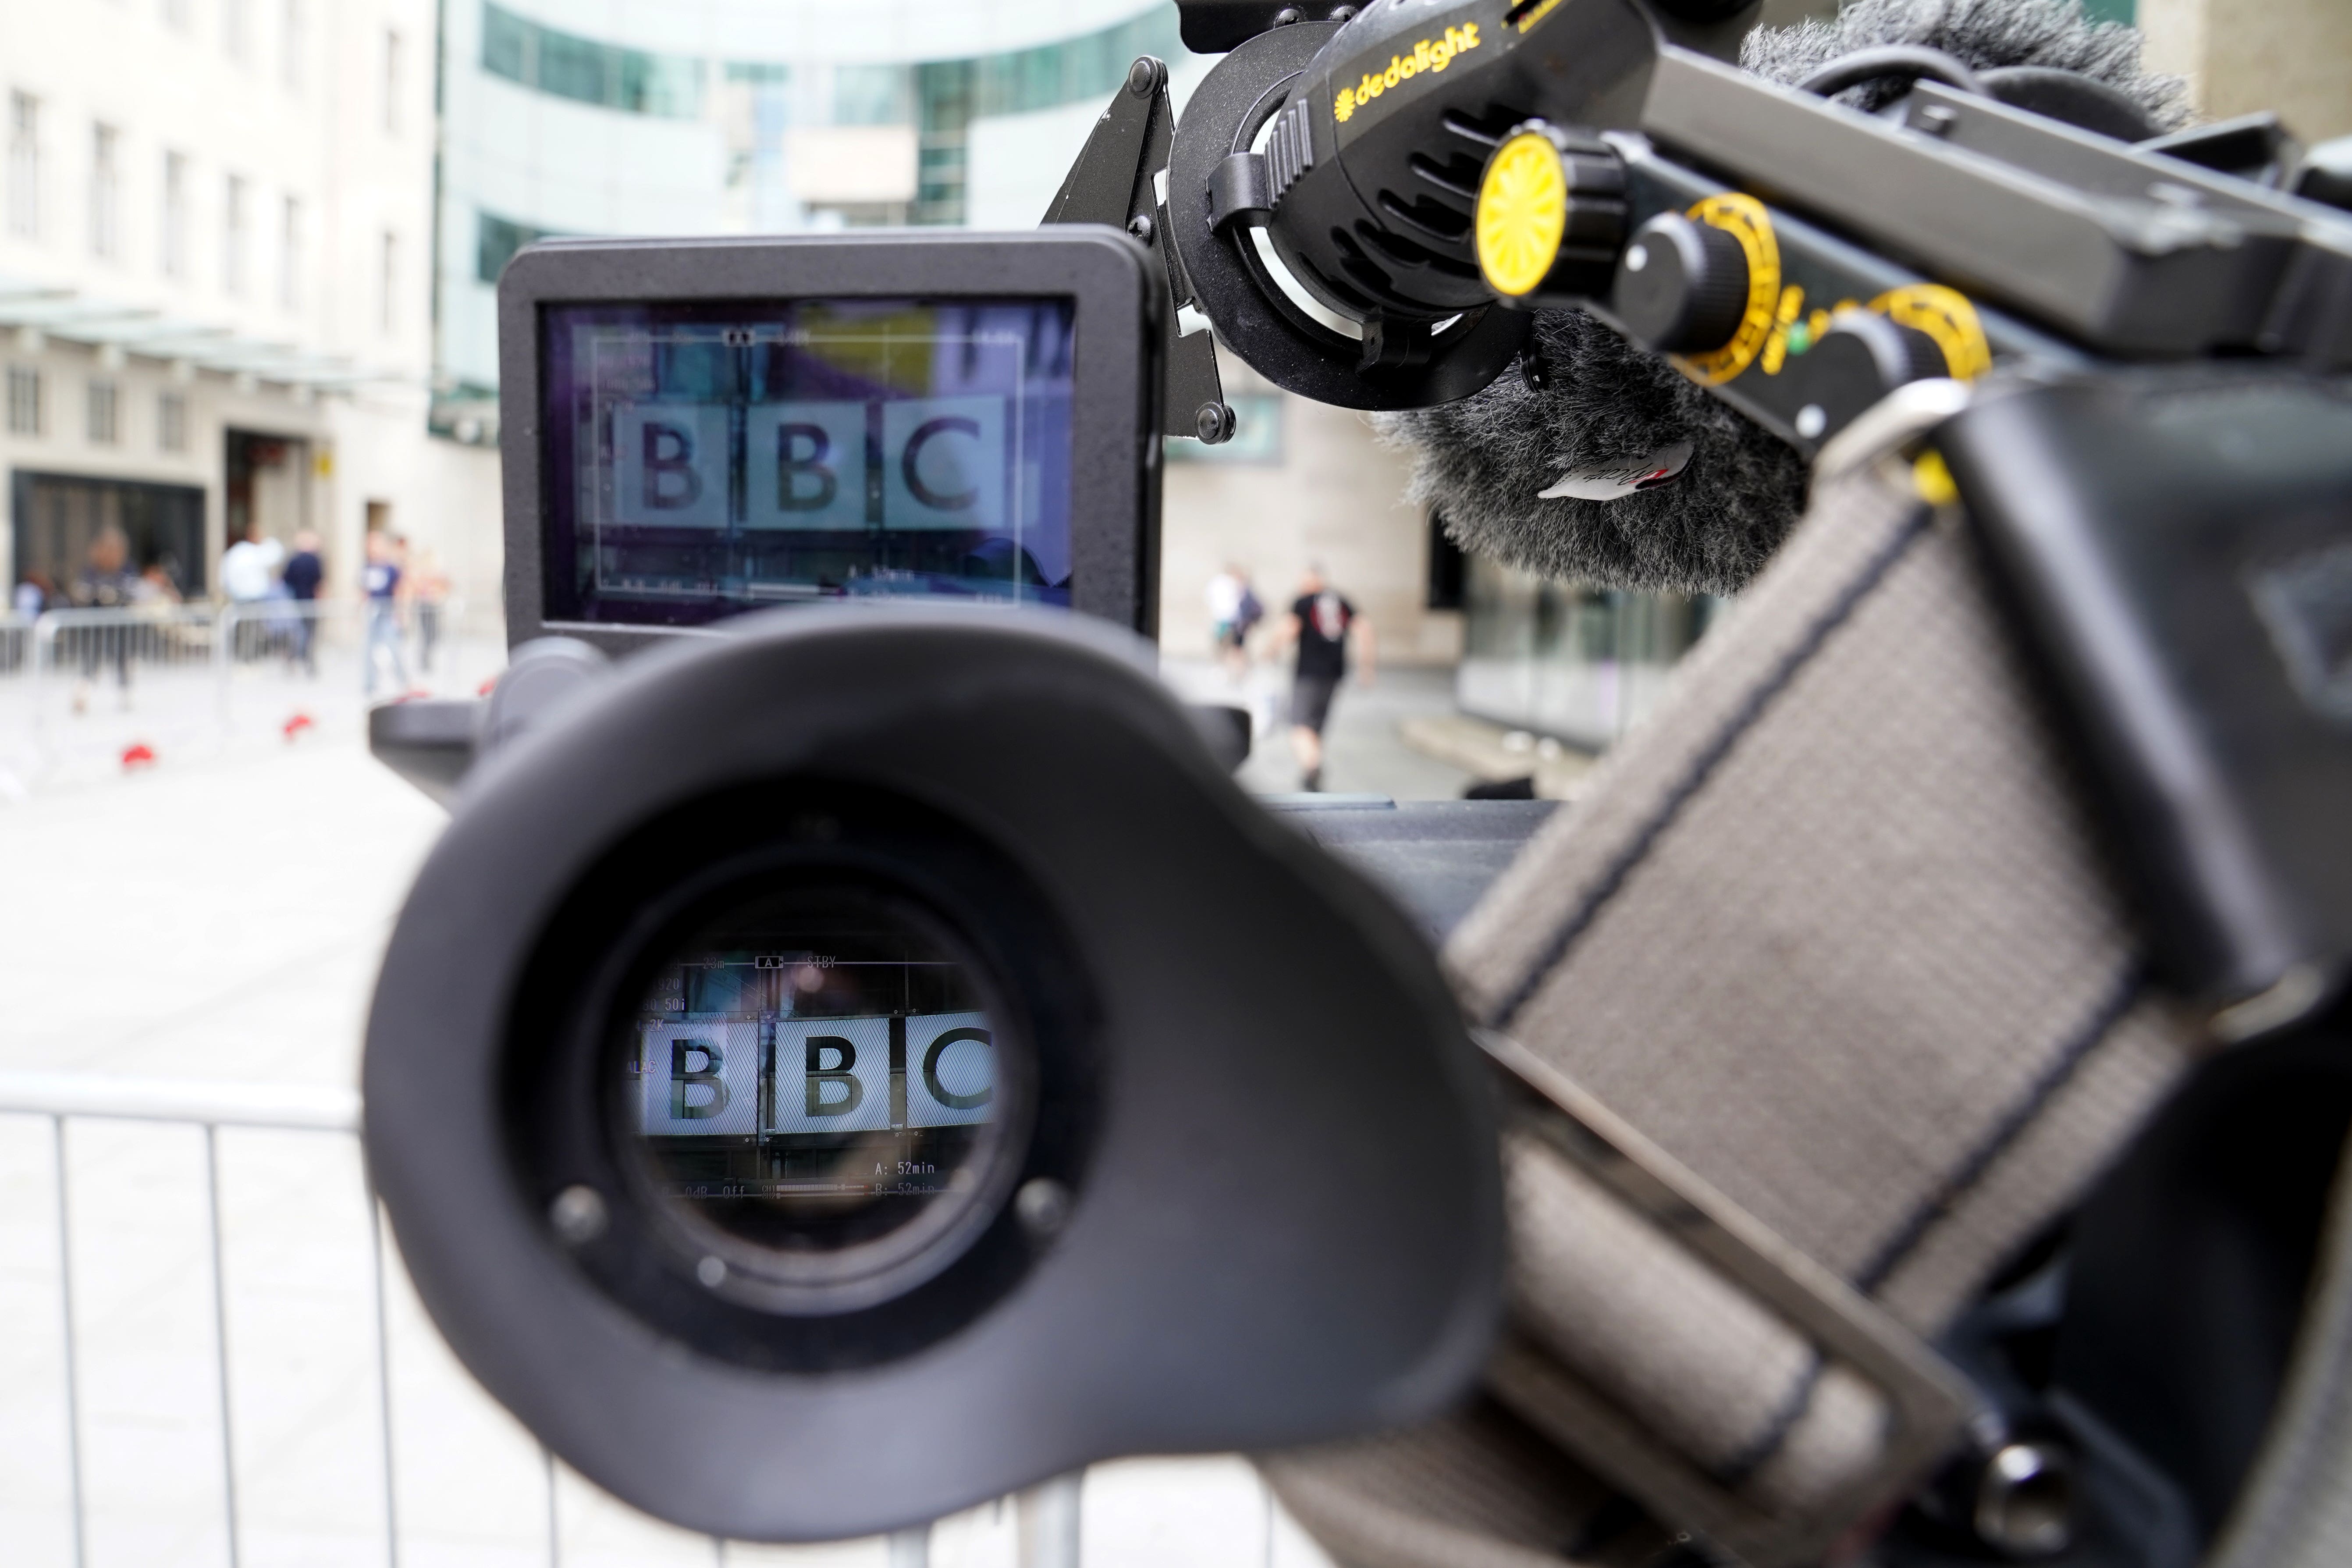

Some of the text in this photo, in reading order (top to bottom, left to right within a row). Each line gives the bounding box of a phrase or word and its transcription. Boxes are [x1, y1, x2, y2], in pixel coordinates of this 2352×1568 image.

[1355, 21, 1481, 106] dedolight
[703, 956, 725, 969] 23m
[764, 957, 773, 967] A
[807, 956, 836, 968] STBY
[657, 978, 680, 990] 920
[664, 997, 685, 1011] 50i
[626, 1060, 656, 1074] ALAC
[875, 1161, 934, 1175] A: 52min
[723, 1185, 745, 1199] Off
[875, 1183, 934, 1196] B: 52min
